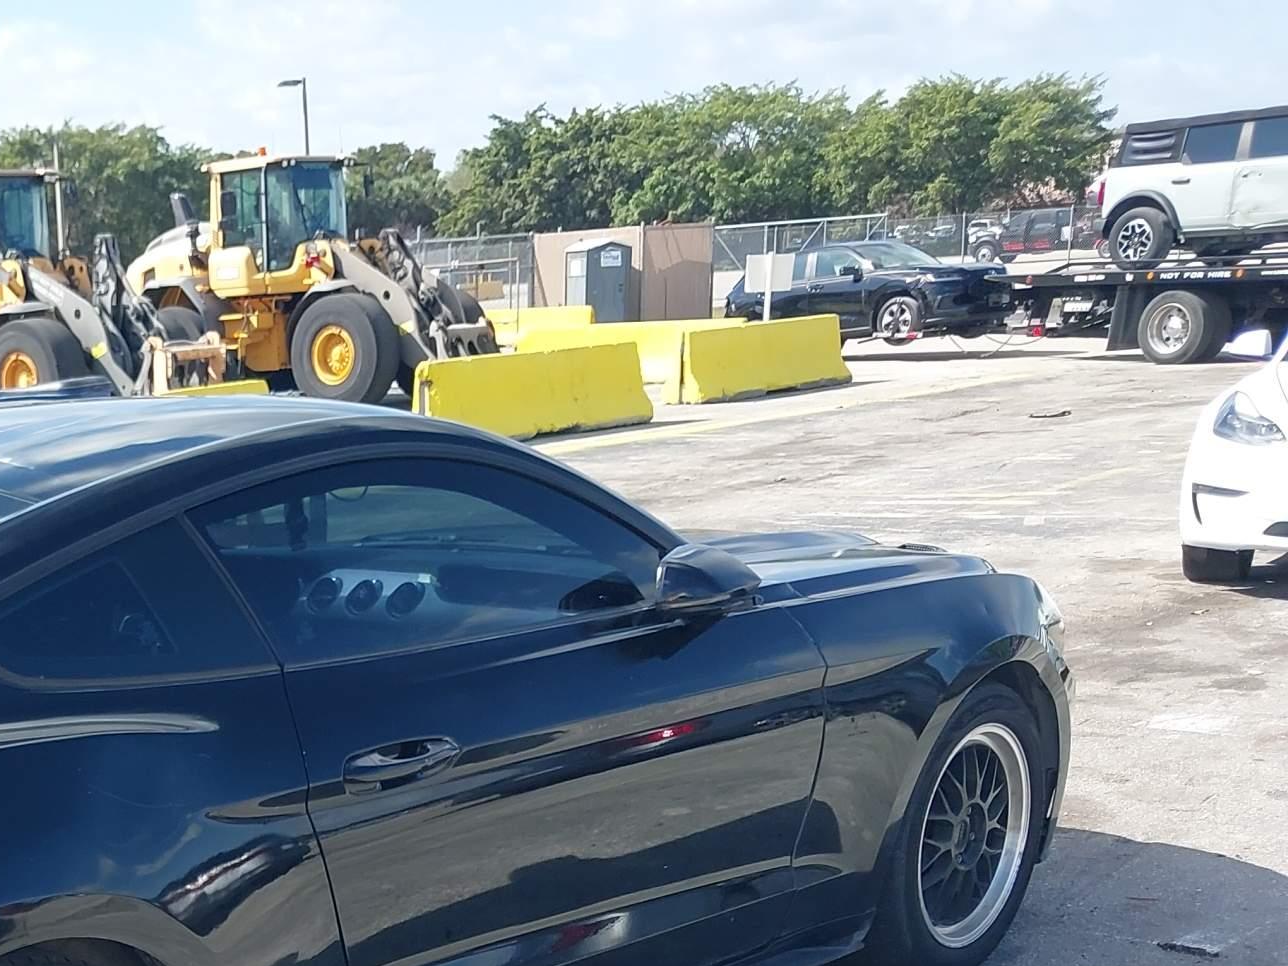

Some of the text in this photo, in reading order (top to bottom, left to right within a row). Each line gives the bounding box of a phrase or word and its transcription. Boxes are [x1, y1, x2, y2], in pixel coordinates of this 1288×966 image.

[1159, 271, 1232, 280] NOT FOR HIRE
